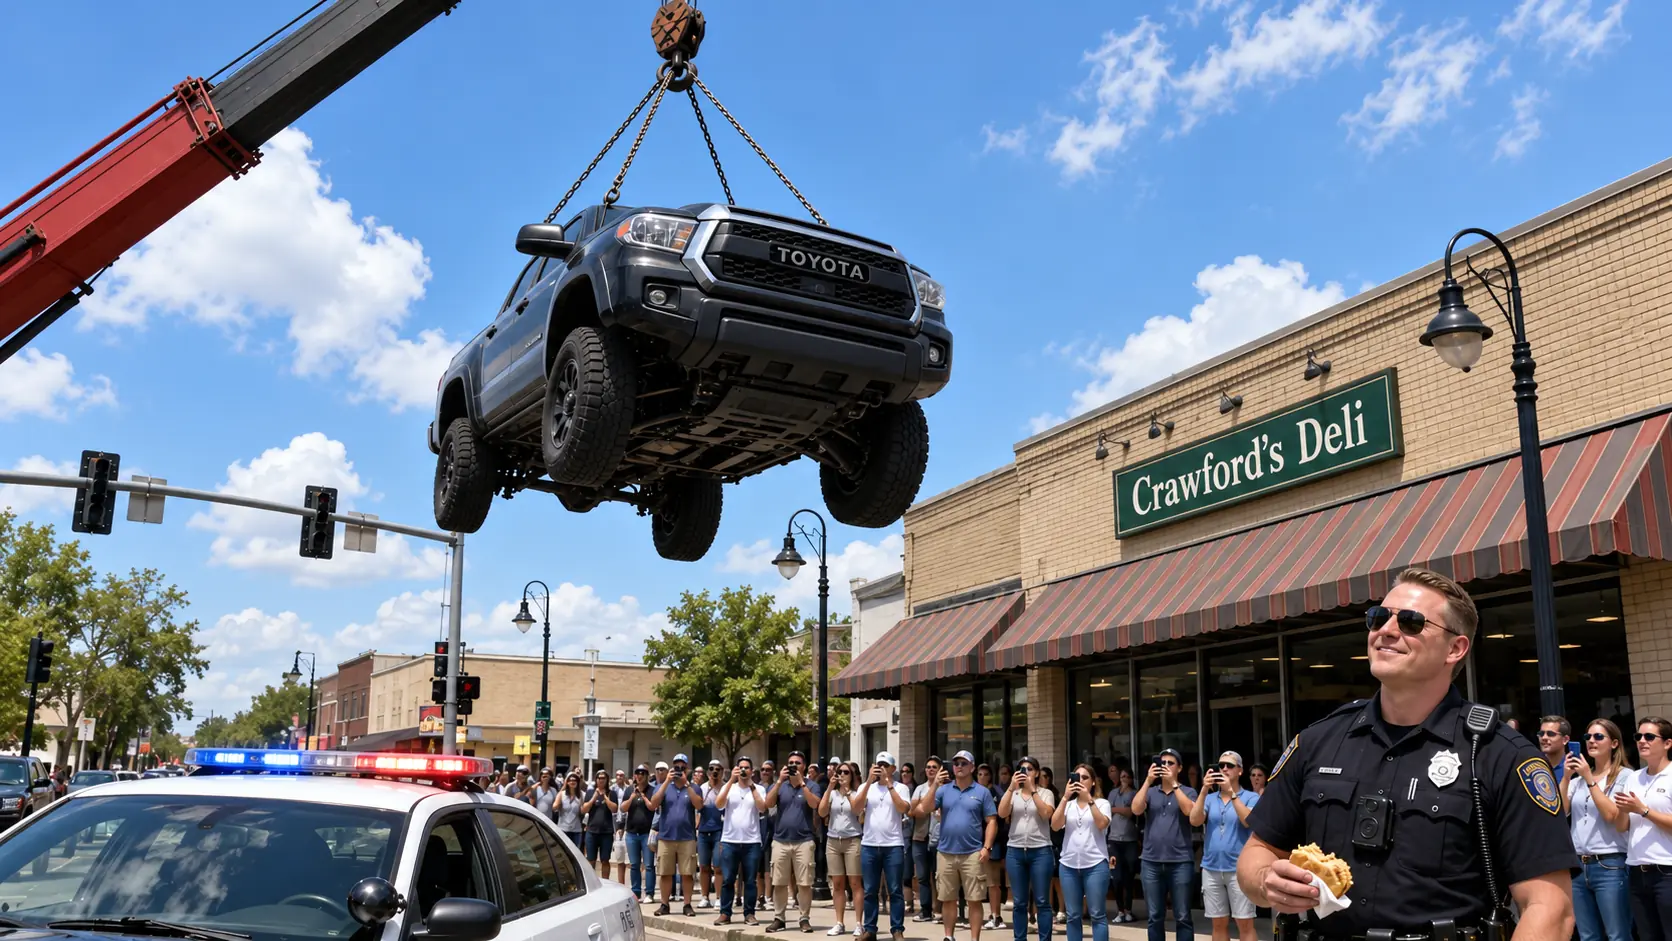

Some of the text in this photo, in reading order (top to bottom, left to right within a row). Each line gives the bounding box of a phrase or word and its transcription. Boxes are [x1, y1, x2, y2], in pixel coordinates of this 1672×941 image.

[777, 246, 864, 280] TOYOTA
[1132, 400, 1368, 516] Crawford's Deli
